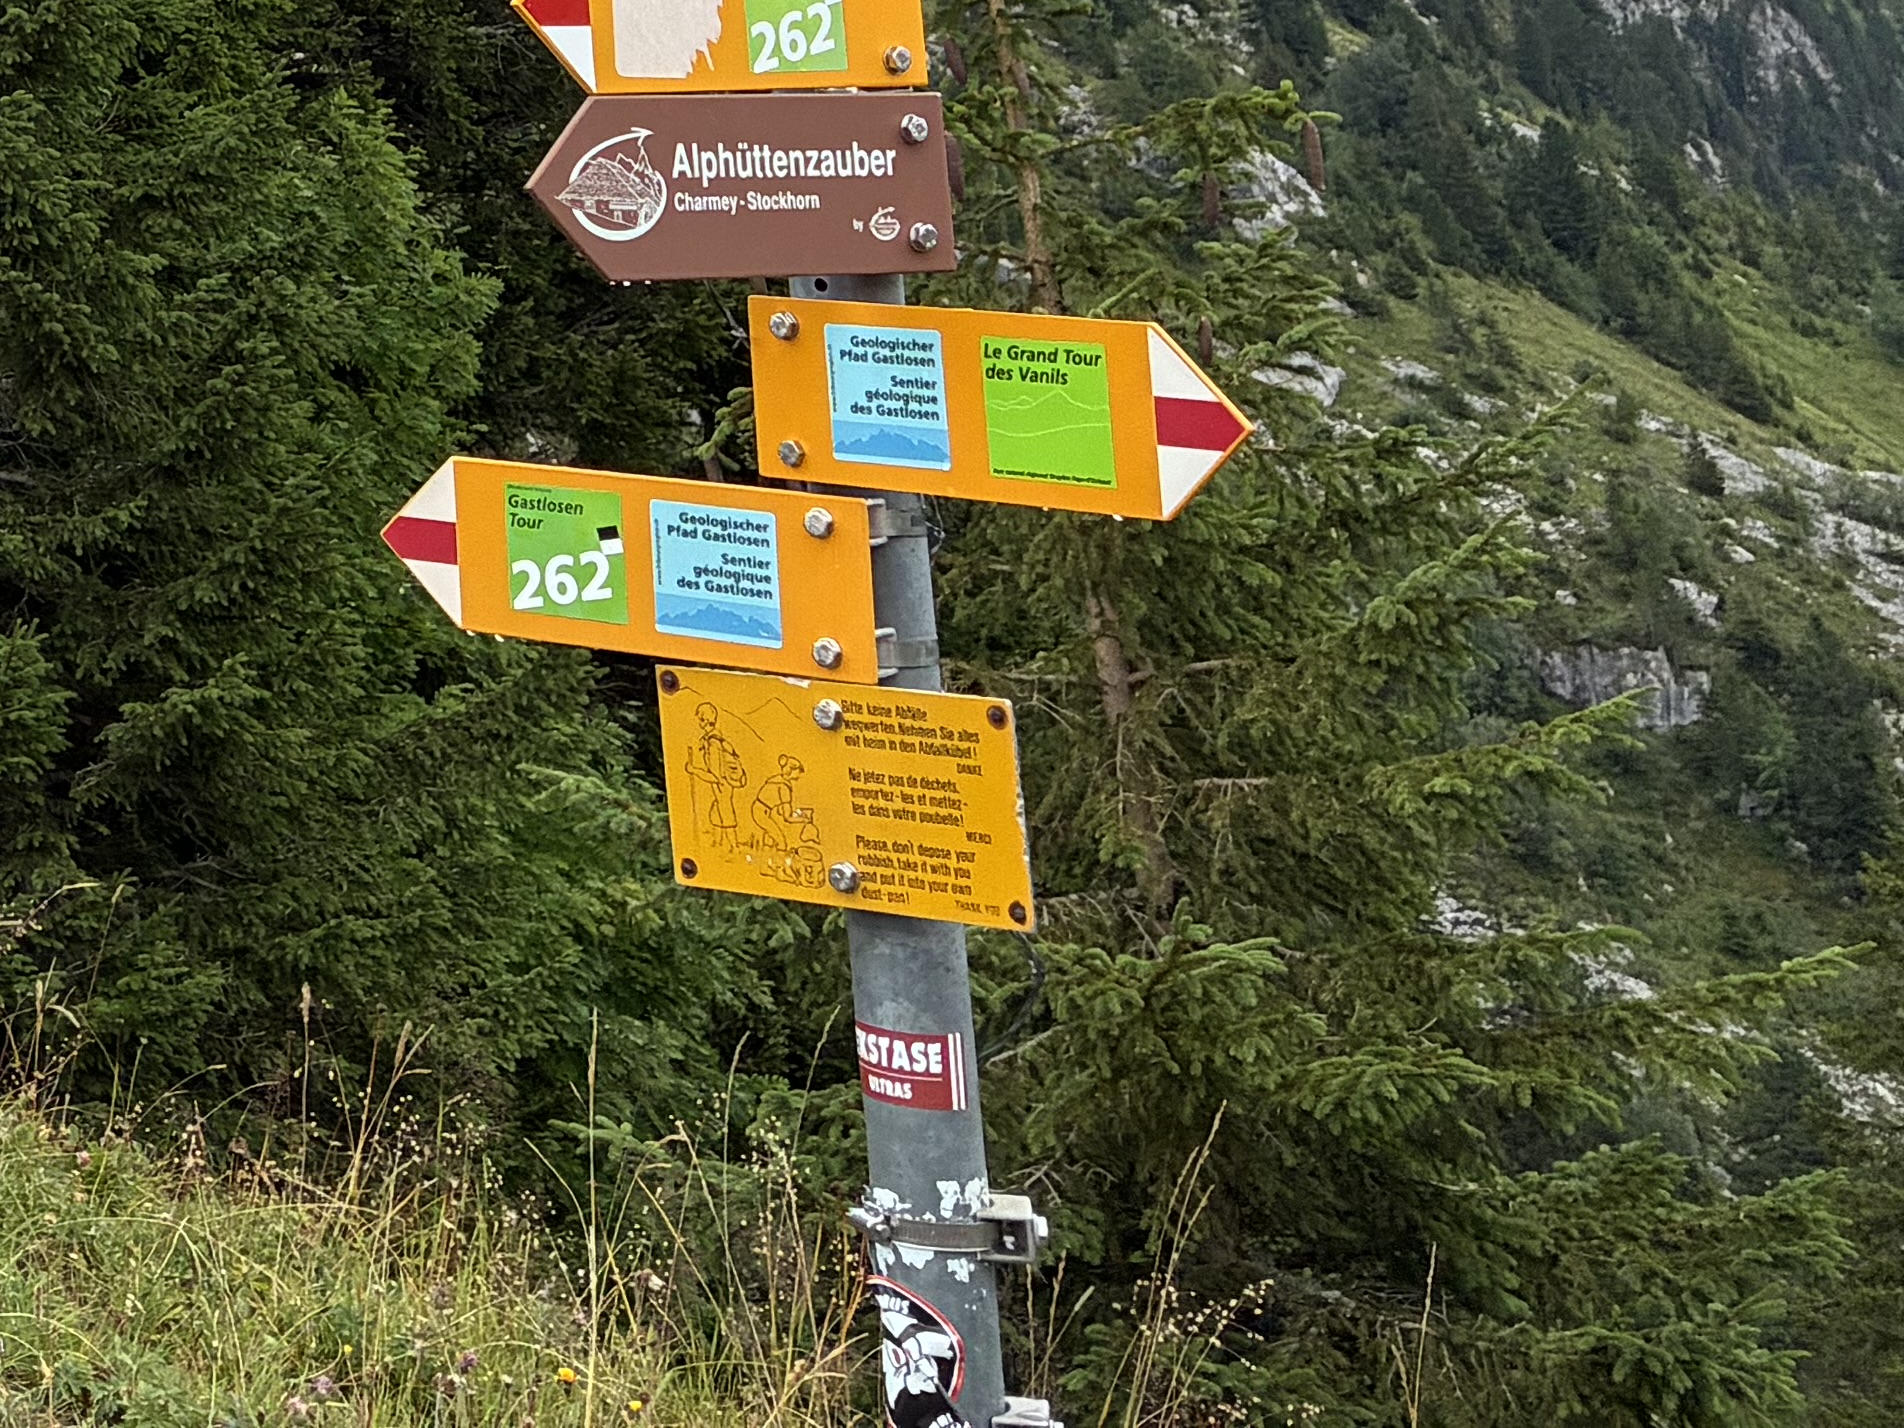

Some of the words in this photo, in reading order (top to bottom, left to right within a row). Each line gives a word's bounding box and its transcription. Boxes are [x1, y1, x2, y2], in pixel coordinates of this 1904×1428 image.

[750, 2, 836, 74] 262
[672, 141, 896, 188] Alphüttenzauber
[850, 335, 934, 353] Geologischer
[983, 342, 1002, 360] Le
[1007, 344, 1059, 364] Grand
[1063, 348, 1102, 367] Tour
[839, 349, 868, 363] Pfad
[872, 351, 936, 368] Gastlosen
[890, 375, 938, 391] Sentier
[985, 363, 1014, 381] des
[1018, 366, 1068, 386] Vanils
[865, 388, 938, 407] géologique
[850, 401, 873, 415] des
[876, 404, 940, 421] Gastlosen
[508, 494, 584, 516] Gastlosen
[509, 512, 544, 530] Tour
[679, 512, 769, 534] Geologischer
[667, 524, 698, 540] Pfad
[702, 529, 770, 549] Gastlosen
[721, 553, 771, 570] Sentier
[512, 550, 613, 610] 262
[693, 564, 772, 585] géologique
[676, 576, 701, 591] des
[704, 580, 773, 600] Gastlosen
[841, 699, 863, 715] Bitte
[866, 702, 892, 718] keine
[939, 725, 955, 741] Sie
[848, 767, 862, 782] Ne
[888, 774, 905, 787] pas
[906, 775, 918, 788] de
[917, 793, 927, 806] et
[851, 801, 866, 816] les
[868, 803, 891, 819] dans
[891, 807, 917, 822] votre
[954, 850, 976, 864] your
[897, 857, 919, 873] take
[920, 860, 928, 874] it
[929, 863, 952, 877] with
[953, 866, 971, 880] you
[859, 871, 877, 884] and
[880, 872, 896, 886] put
[898, 873, 905, 886] it
[907, 874, 926, 890] into
[927, 880, 949, 894] your
[951, 884, 972, 896] own
